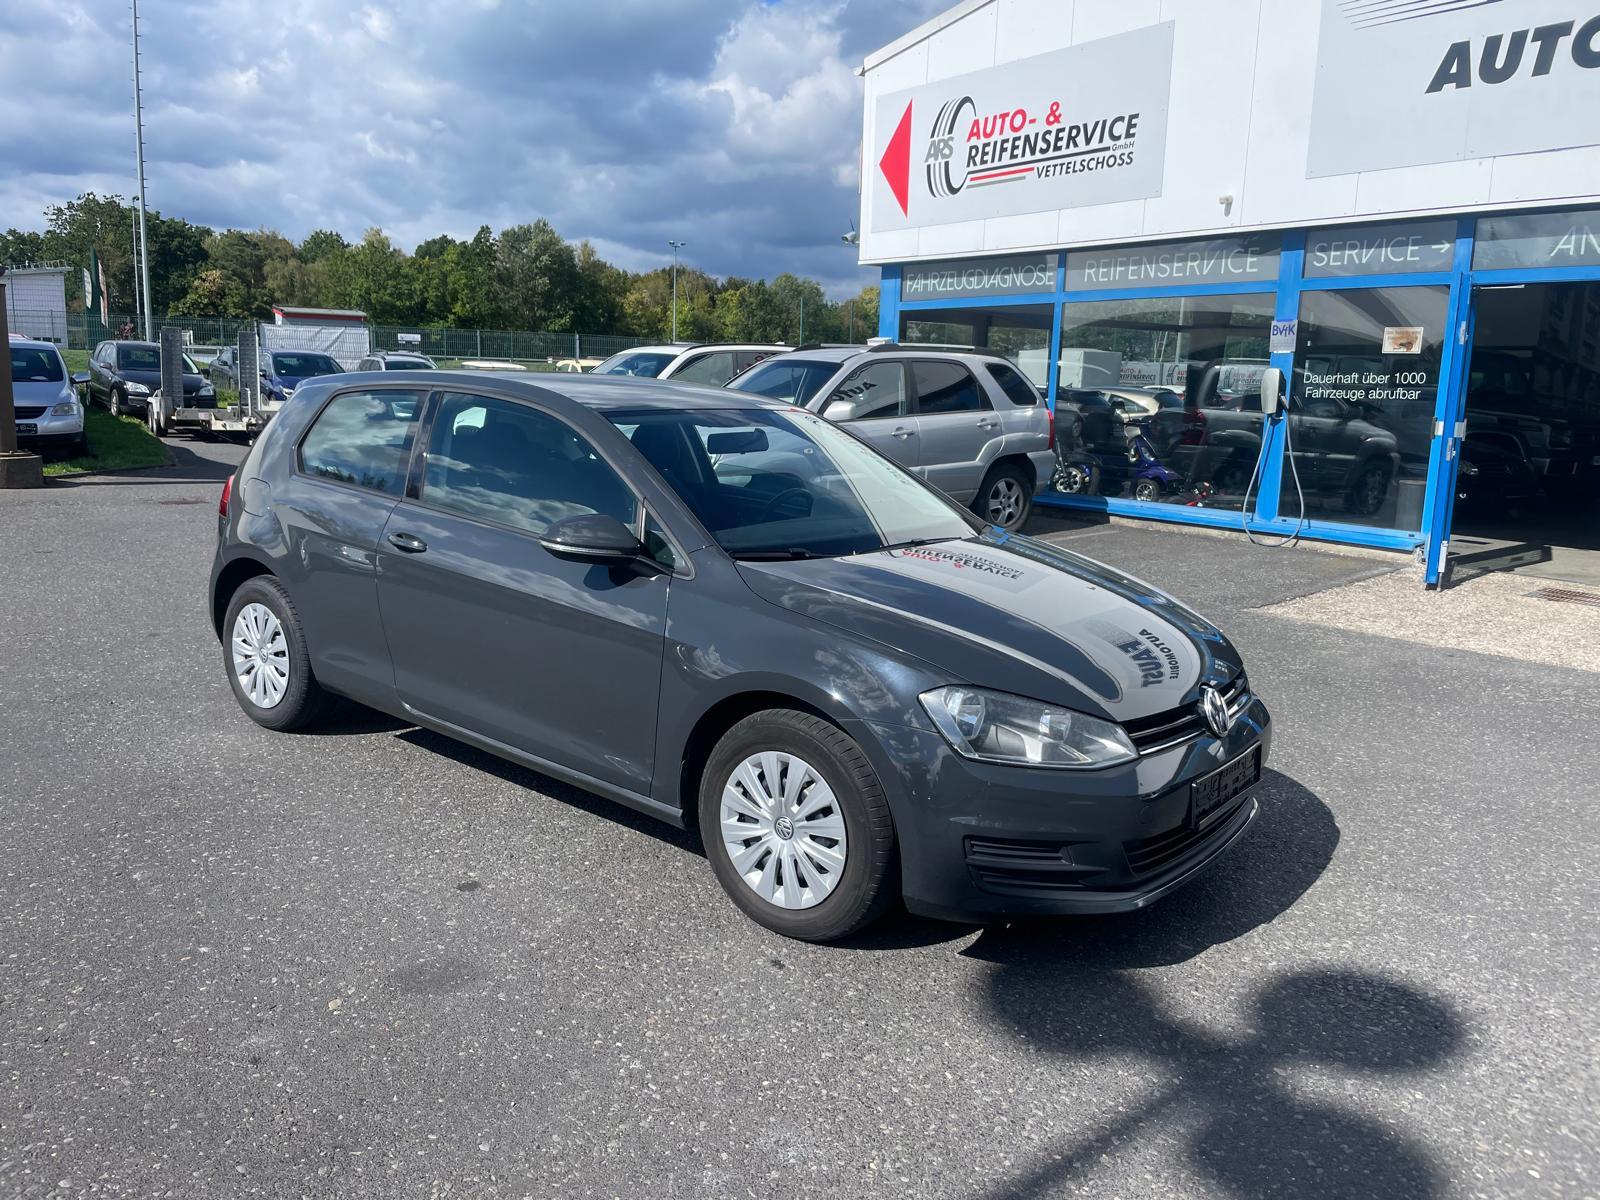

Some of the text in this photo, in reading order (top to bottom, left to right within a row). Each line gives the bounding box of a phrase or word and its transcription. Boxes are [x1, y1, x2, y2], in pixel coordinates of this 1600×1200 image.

[966, 101, 1062, 142] AUTO- &
[924, 136, 954, 163] ARS
[966, 113, 1140, 168] REIFENSERVICE
[1111, 140, 1135, 152] GmbH
[1036, 152, 1134, 179] VETTELSCHOSS
[1084, 247, 1260, 282] REIFENSERVICE
[1312, 235, 1423, 267] SERVICE
[906, 263, 1056, 293] FAHRZEUGDIAGNOSE
[1303, 372, 1426, 384] Dauerhaft über 1000
[1305, 386, 1421, 401] Fahrzeuge abrufbar
